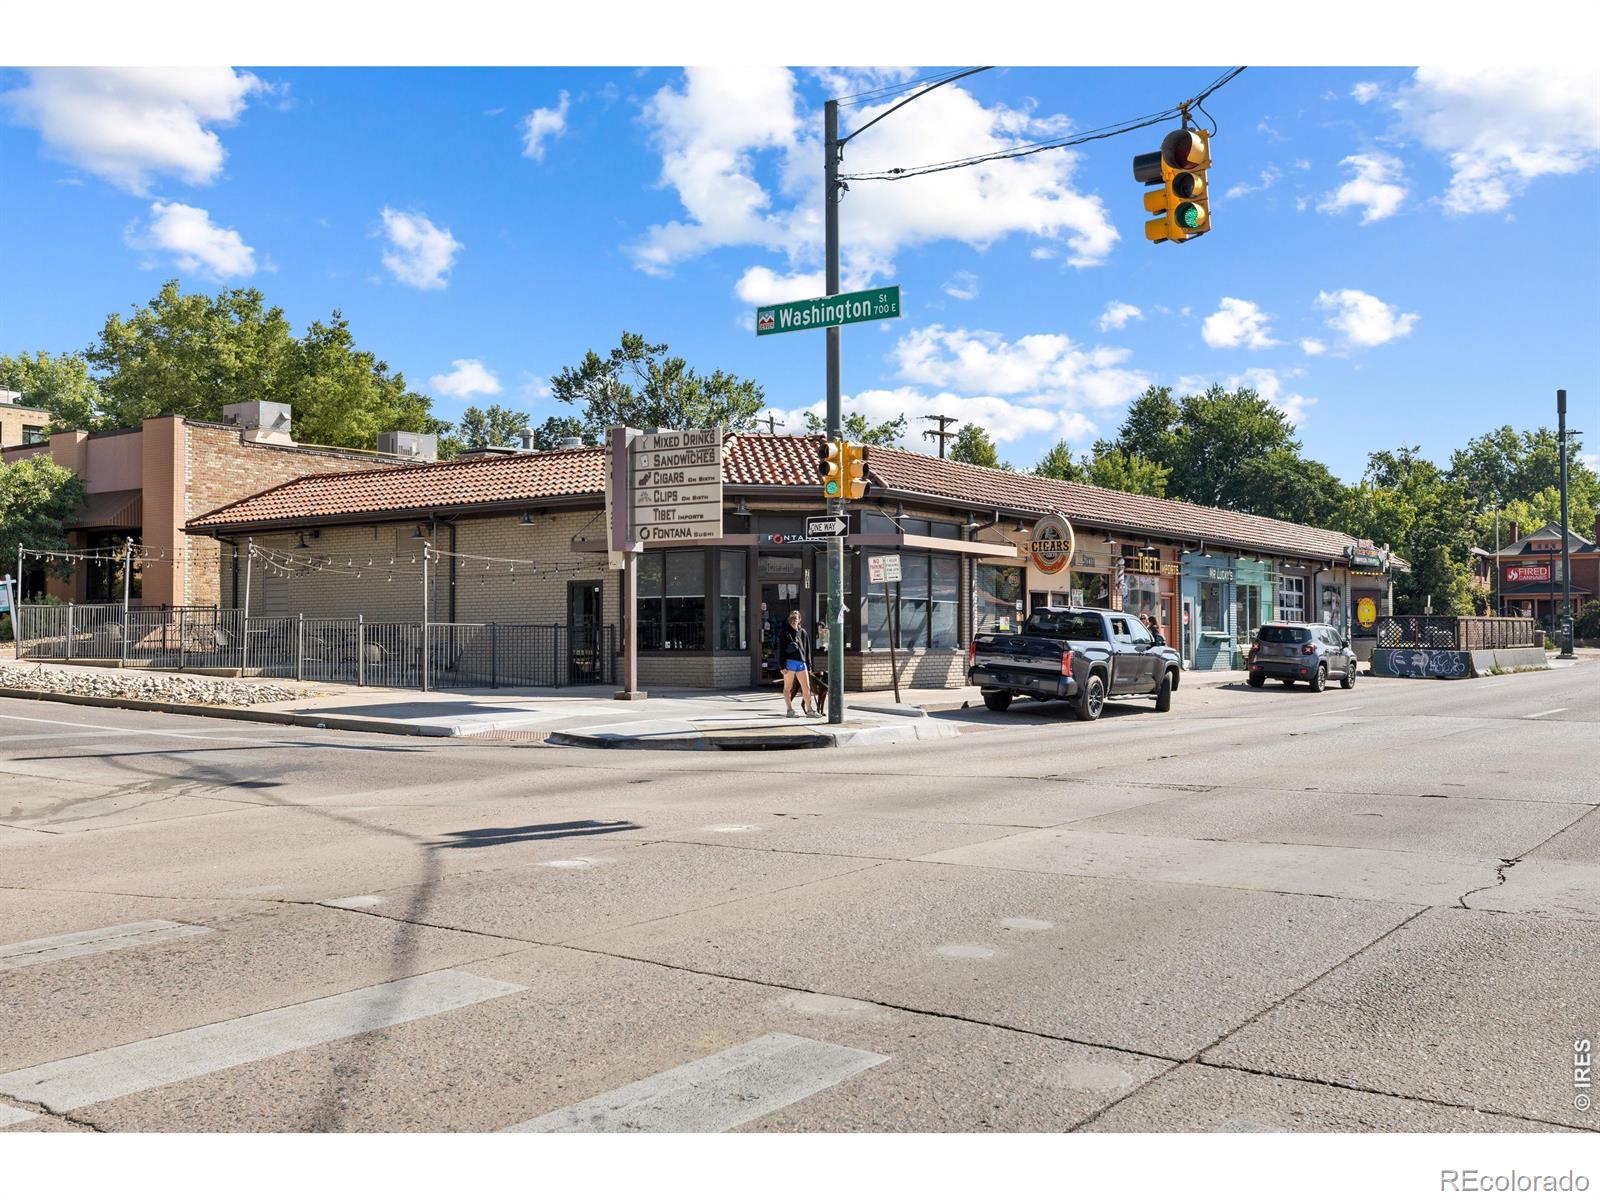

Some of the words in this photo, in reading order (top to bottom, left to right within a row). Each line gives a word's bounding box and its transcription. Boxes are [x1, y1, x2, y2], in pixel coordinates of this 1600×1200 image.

[779, 299, 871, 328] Washington
[878, 294, 887, 302] St
[873, 304, 889, 315] 700
[891, 303, 896, 312] E
[653, 436, 680, 449] MIXED
[683, 432, 715, 447] DRINKS
[653, 452, 715, 467] SANDWICHES
[653, 472, 685, 484] CIGARS
[653, 490, 678, 503] CLIPS
[652, 508, 676, 521] TIBET
[653, 527, 692, 539] FONTANA
[811, 523, 822, 532] ONE
[824, 522, 836, 531] WAY
[767, 533, 826, 544] FONTA
[1031, 540, 1070, 552] CIGARS
[1138, 552, 1158, 574] TIBET
[1518, 567, 1548, 576] FIRED
